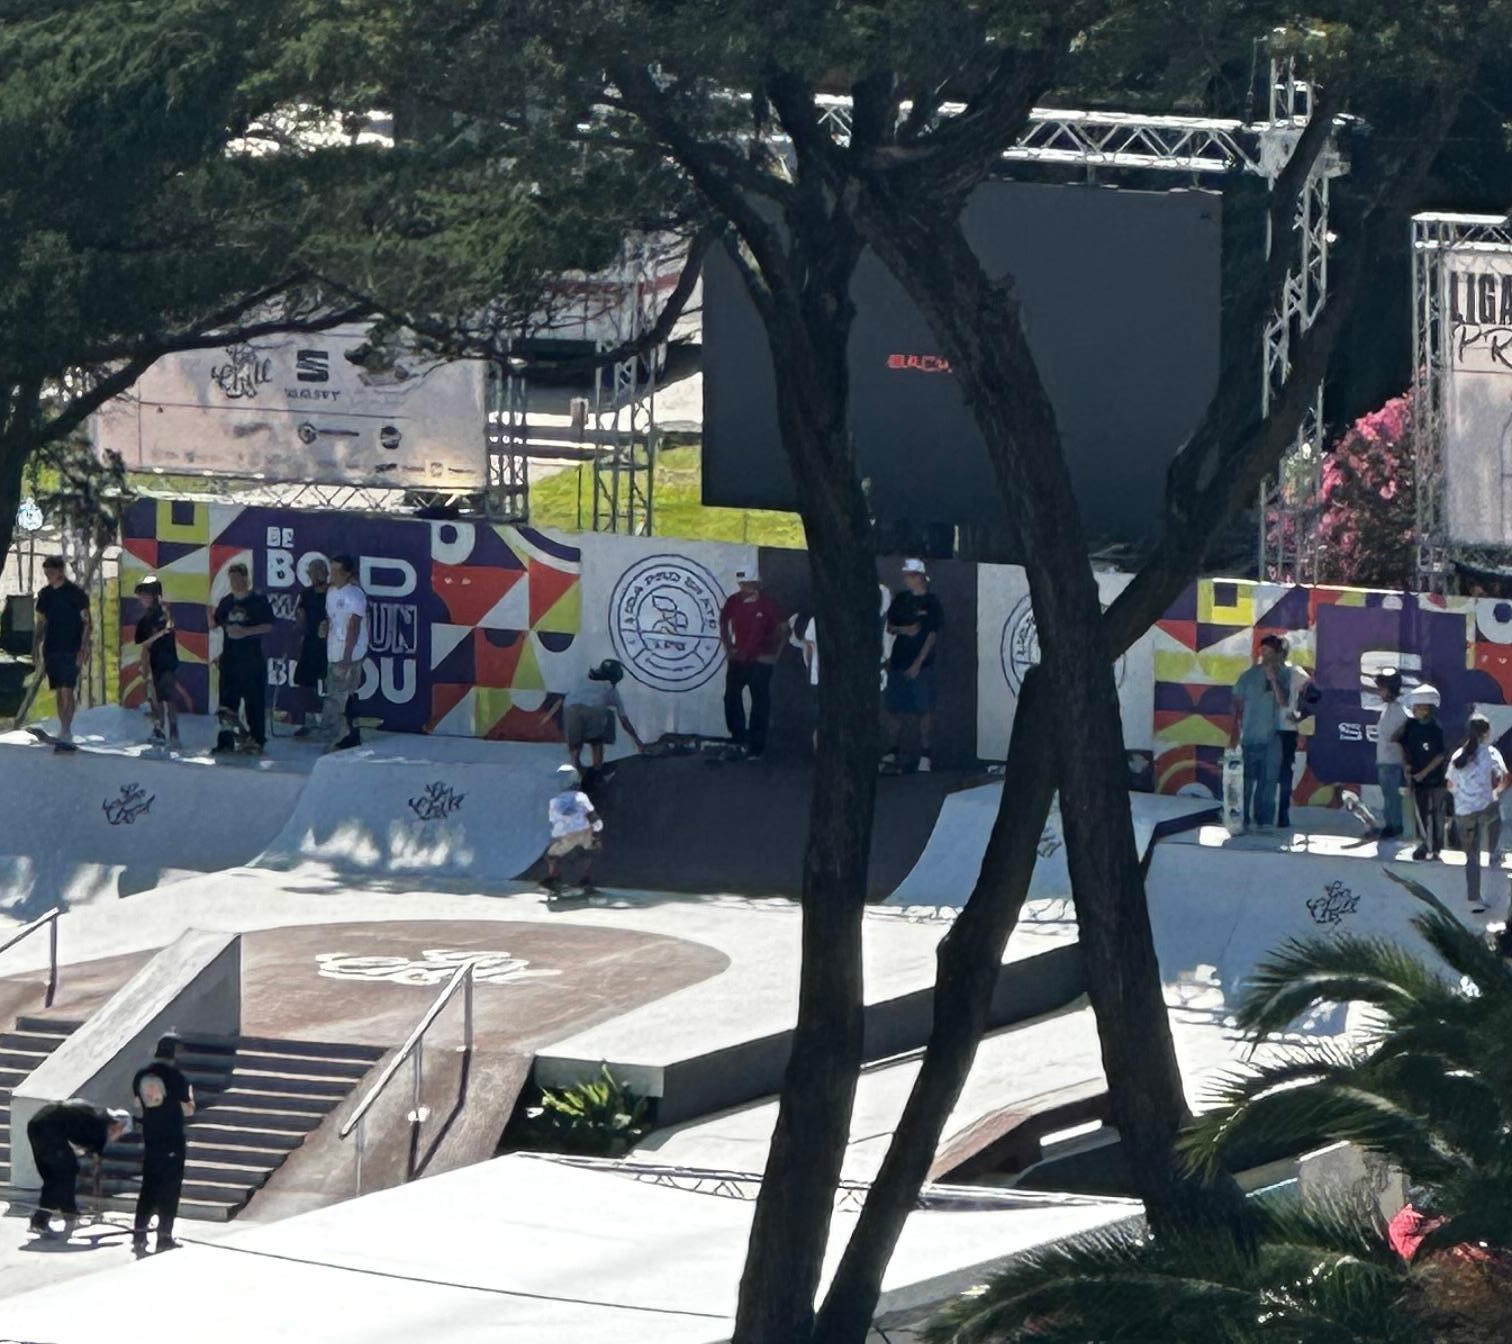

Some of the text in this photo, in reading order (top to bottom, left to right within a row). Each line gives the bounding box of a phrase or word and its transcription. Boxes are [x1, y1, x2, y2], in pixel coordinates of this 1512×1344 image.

[266, 526, 295, 548] BE
[266, 548, 418, 598] BOD
[1338, 722, 1380, 743] SE
